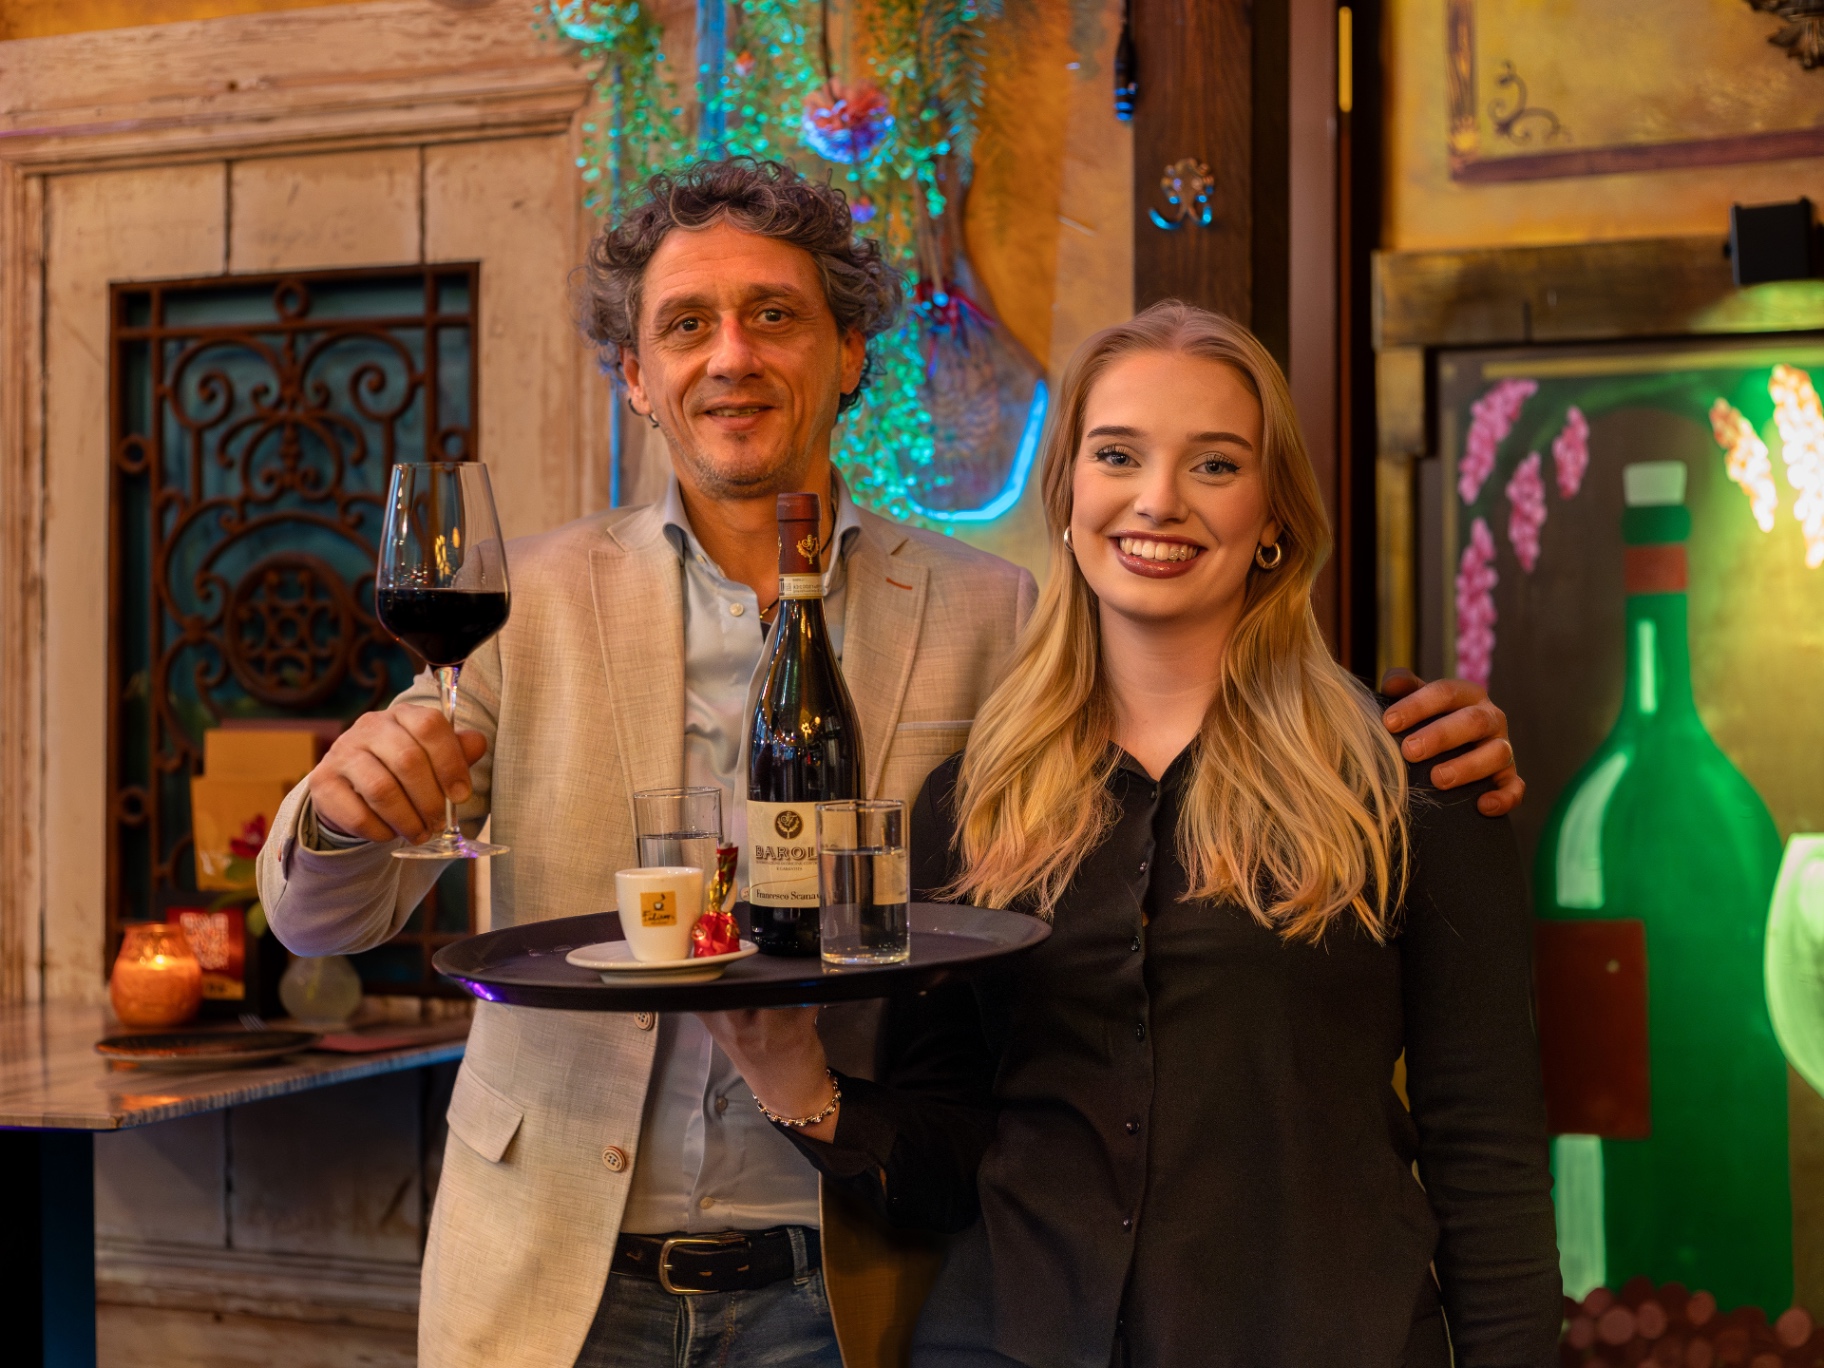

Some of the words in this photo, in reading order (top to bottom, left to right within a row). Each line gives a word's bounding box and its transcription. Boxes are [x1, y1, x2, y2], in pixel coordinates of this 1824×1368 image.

[755, 845, 818, 861] BAROL
[756, 889, 789, 900] Francesco
[790, 891, 820, 900] Scana
